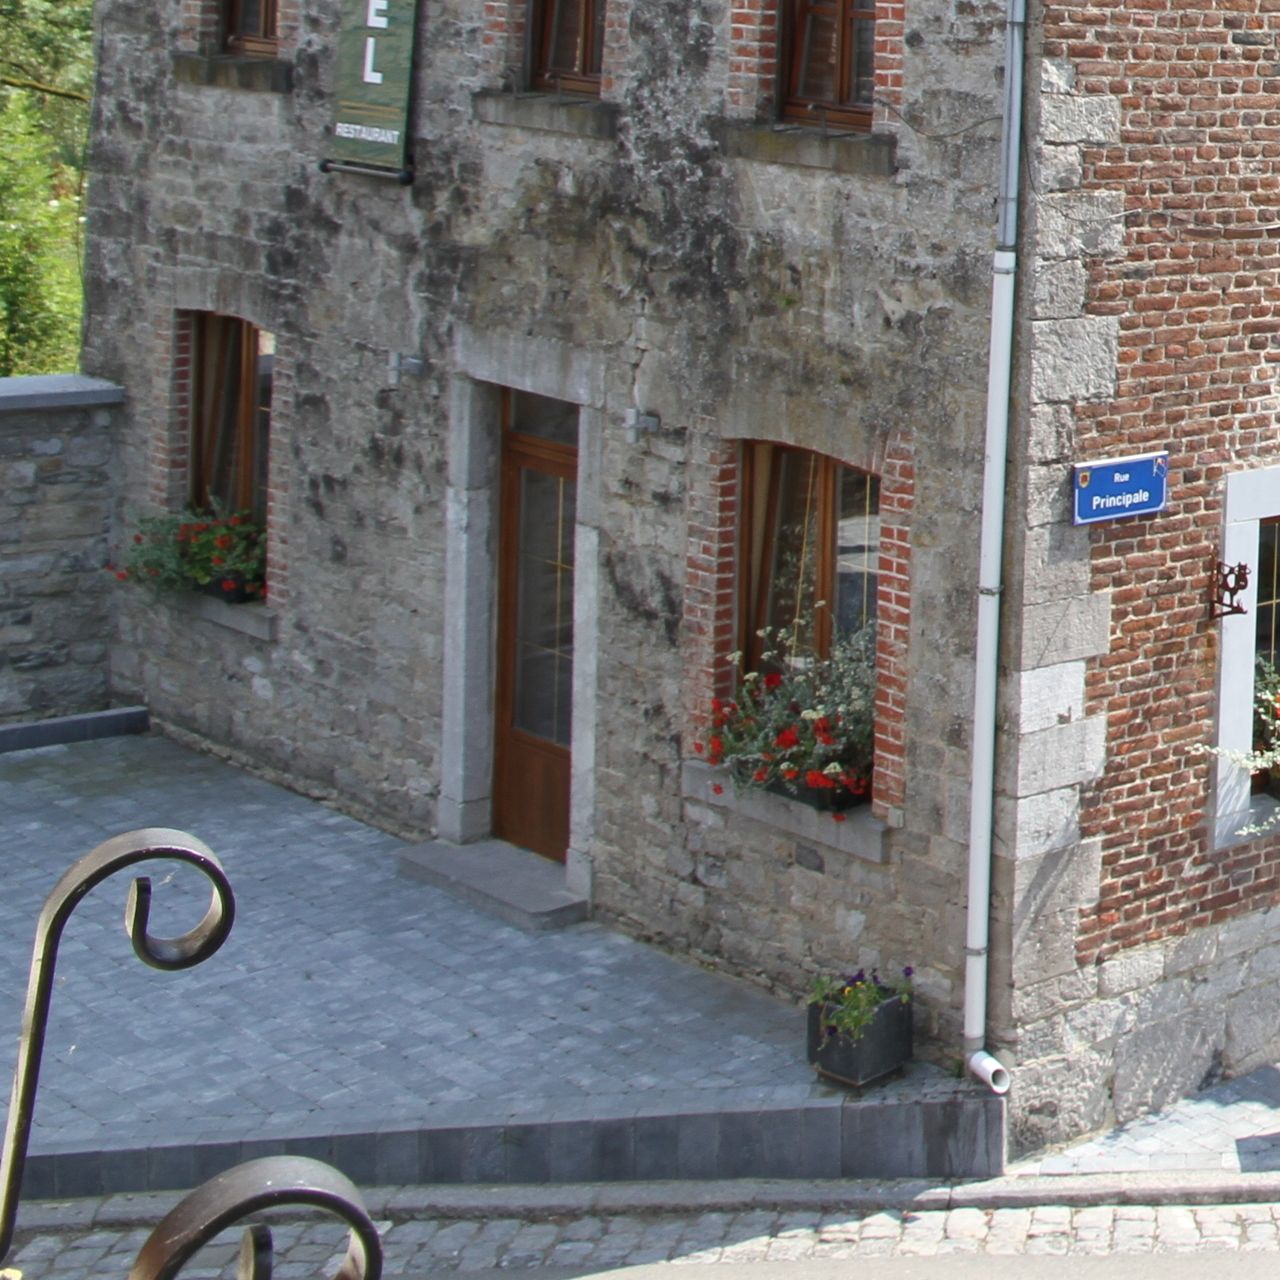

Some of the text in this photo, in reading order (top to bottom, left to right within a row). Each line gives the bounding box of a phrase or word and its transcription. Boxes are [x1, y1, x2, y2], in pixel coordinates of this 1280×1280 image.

[335, 122, 400, 145] RESTAURANT
[1114, 472, 1130, 483] Rue
[1092, 489, 1149, 510] Principale
